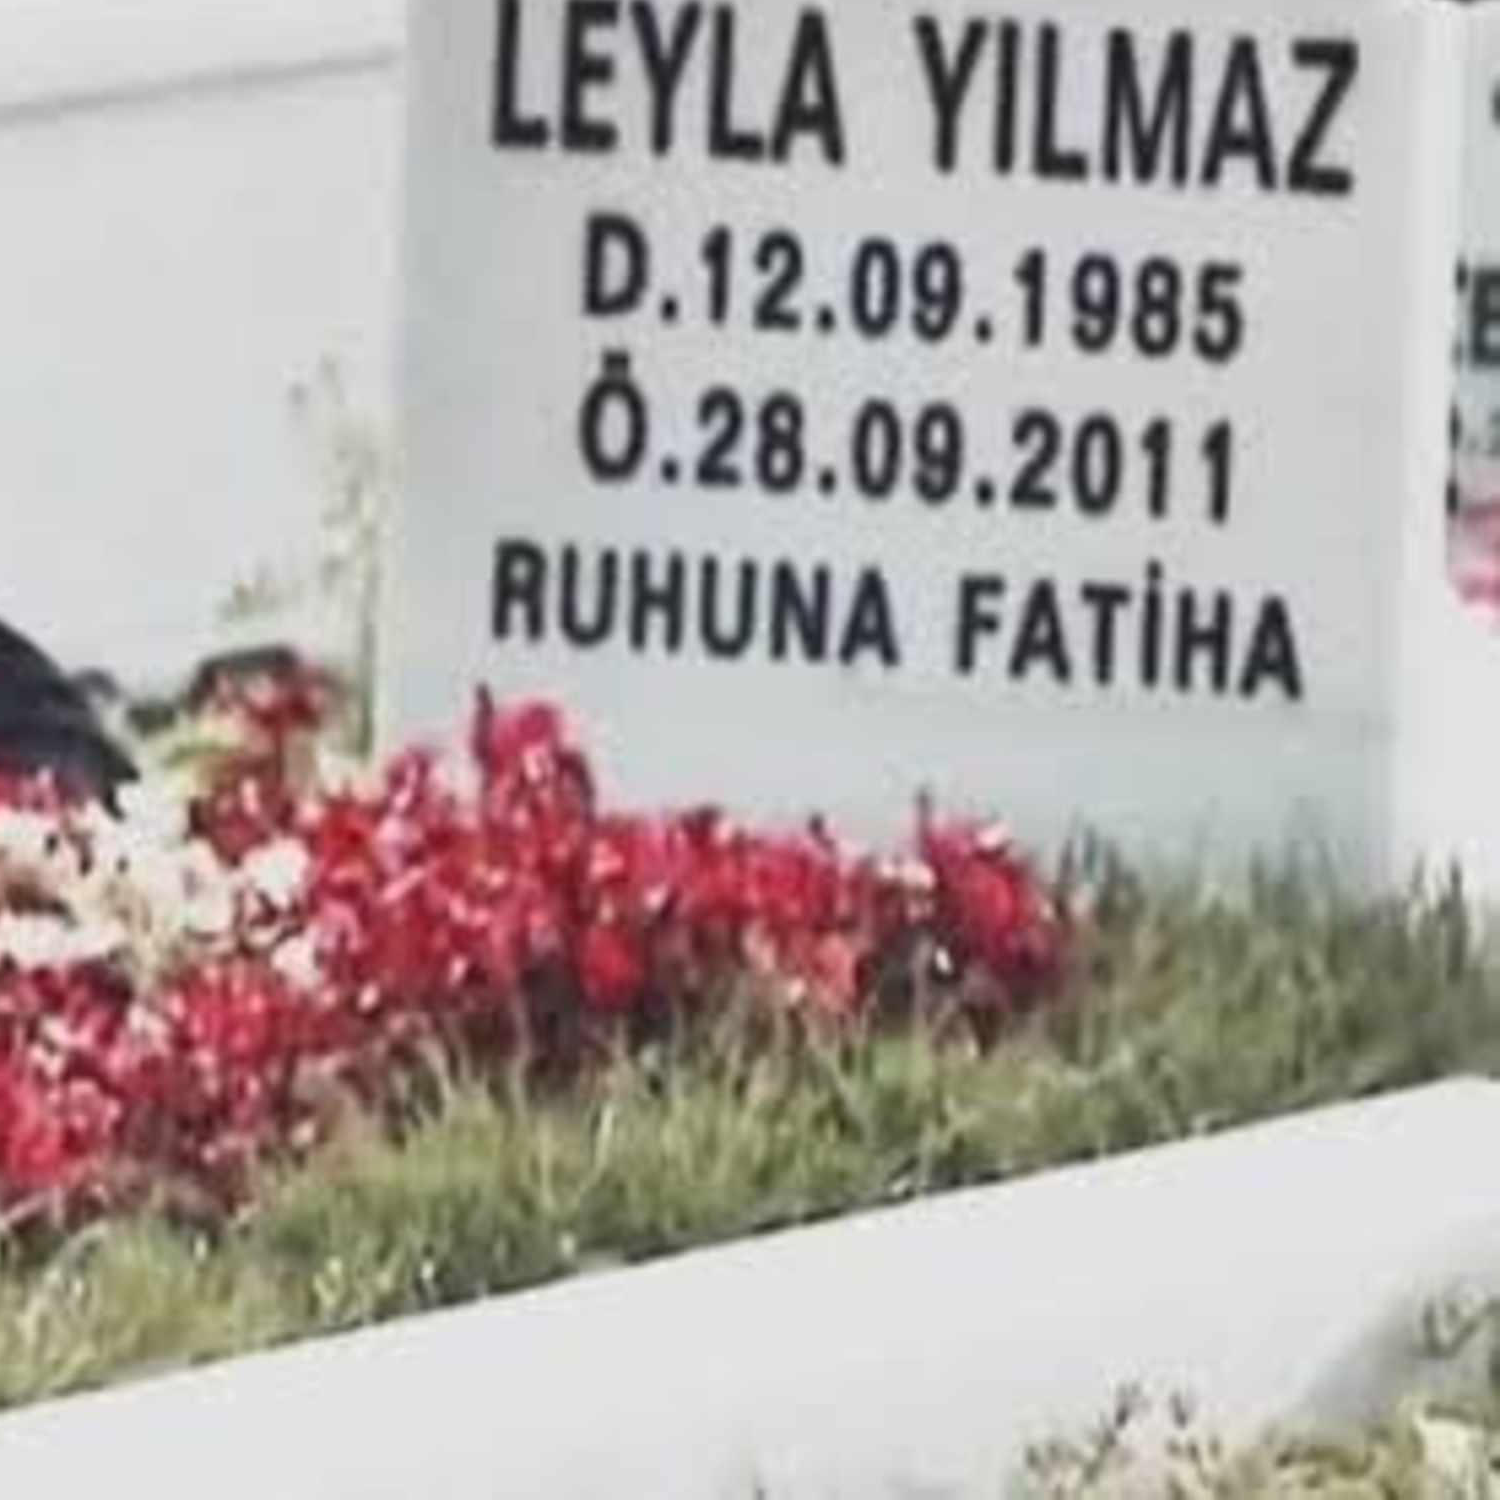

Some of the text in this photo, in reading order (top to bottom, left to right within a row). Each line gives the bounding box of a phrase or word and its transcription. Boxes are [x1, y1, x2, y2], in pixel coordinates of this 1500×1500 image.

[912, 14, 1360, 198] YILMAZ
[582, 211, 1244, 365] D.12.09.1985
[577, 349, 1232, 525] Ö.28.09.2011
[491, 538, 1303, 702] RUHUNA FATİHA
